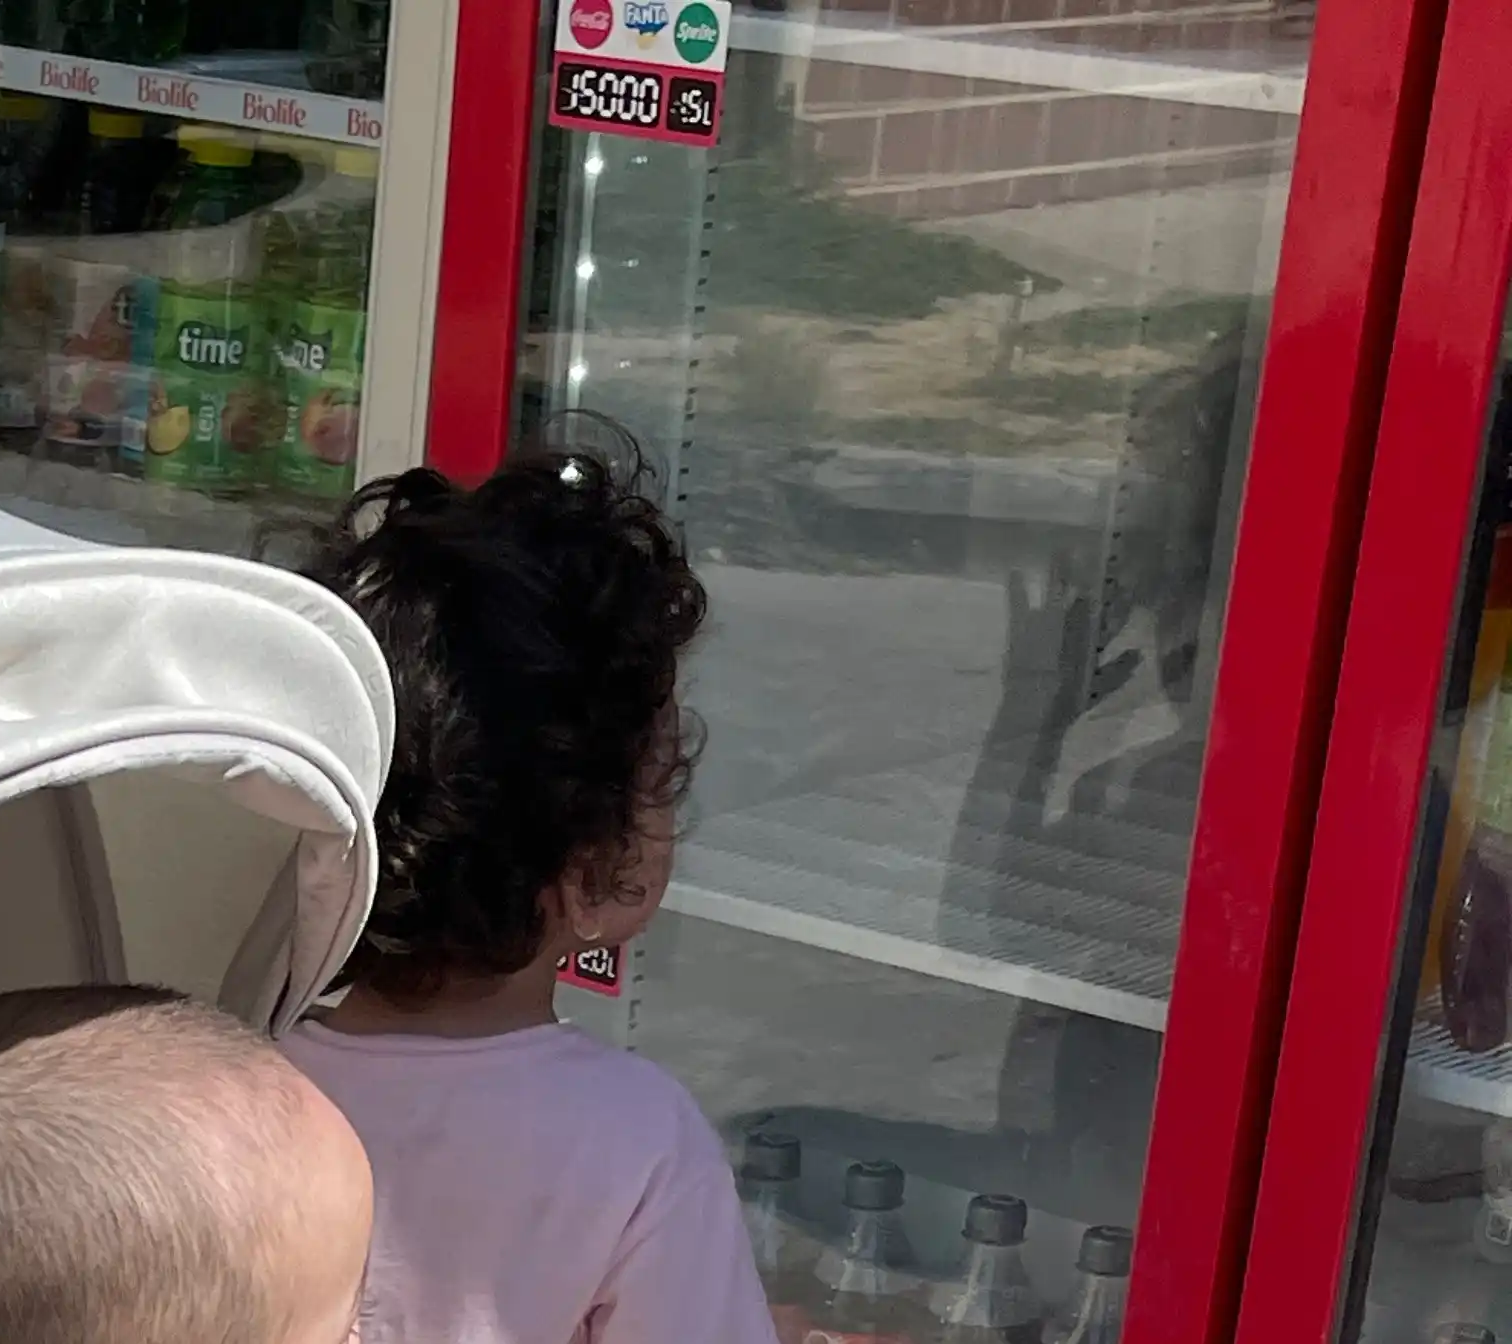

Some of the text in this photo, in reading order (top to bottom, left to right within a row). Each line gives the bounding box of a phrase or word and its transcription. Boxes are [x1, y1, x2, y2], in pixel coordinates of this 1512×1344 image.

[676, 22, 717, 43] Sprite
[40, 60, 100, 95] Biolife
[138, 76, 200, 111] Biolife
[243, 92, 307, 128] Biolife
[571, 69, 660, 123] 15000
[178, 328, 244, 365] time
